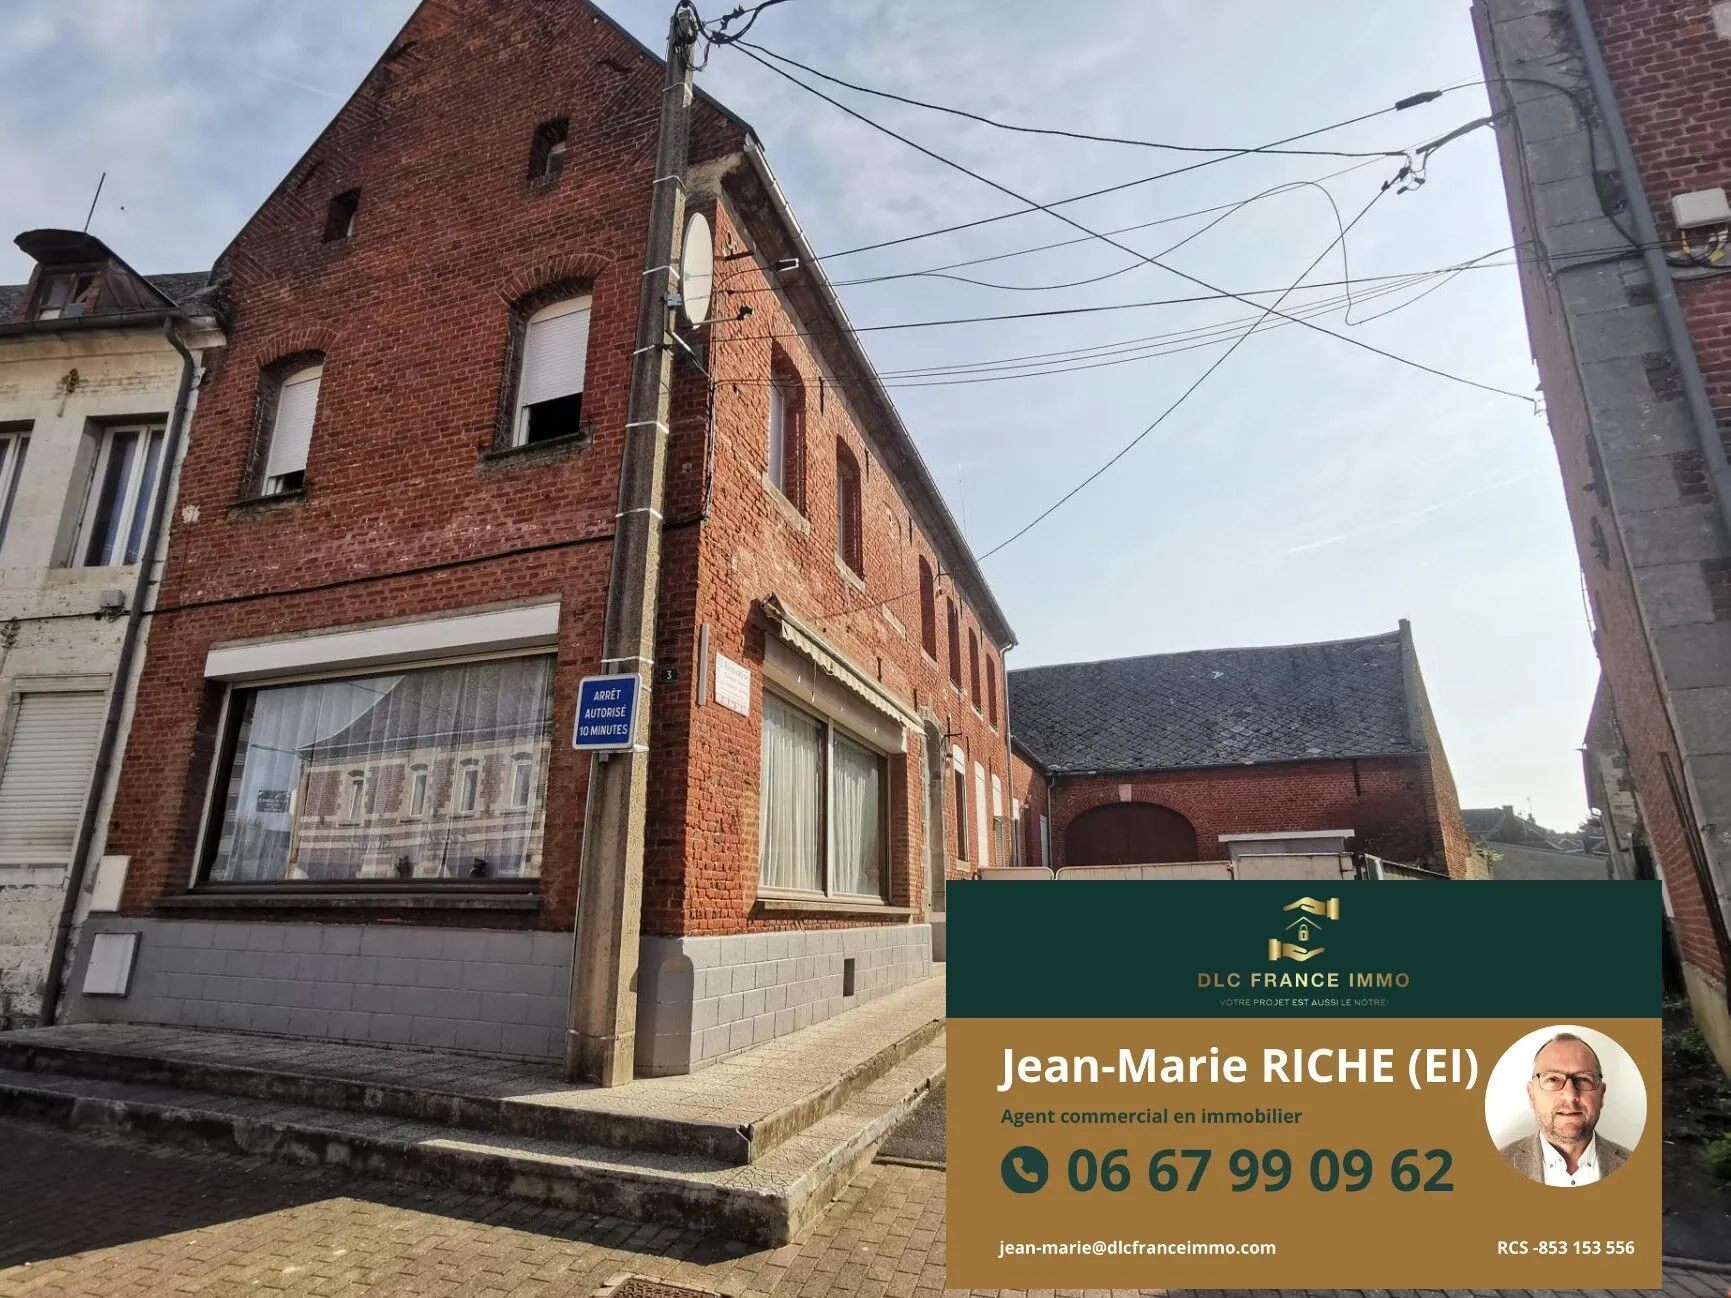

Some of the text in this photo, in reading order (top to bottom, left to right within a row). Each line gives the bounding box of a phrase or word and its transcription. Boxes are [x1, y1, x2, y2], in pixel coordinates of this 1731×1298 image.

[666, 670, 672, 680] 3
[593, 688, 622, 701] ARRÊT
[584, 704, 627, 719] AUTORISÉ
[579, 724, 628, 737] 10 MINUTES
